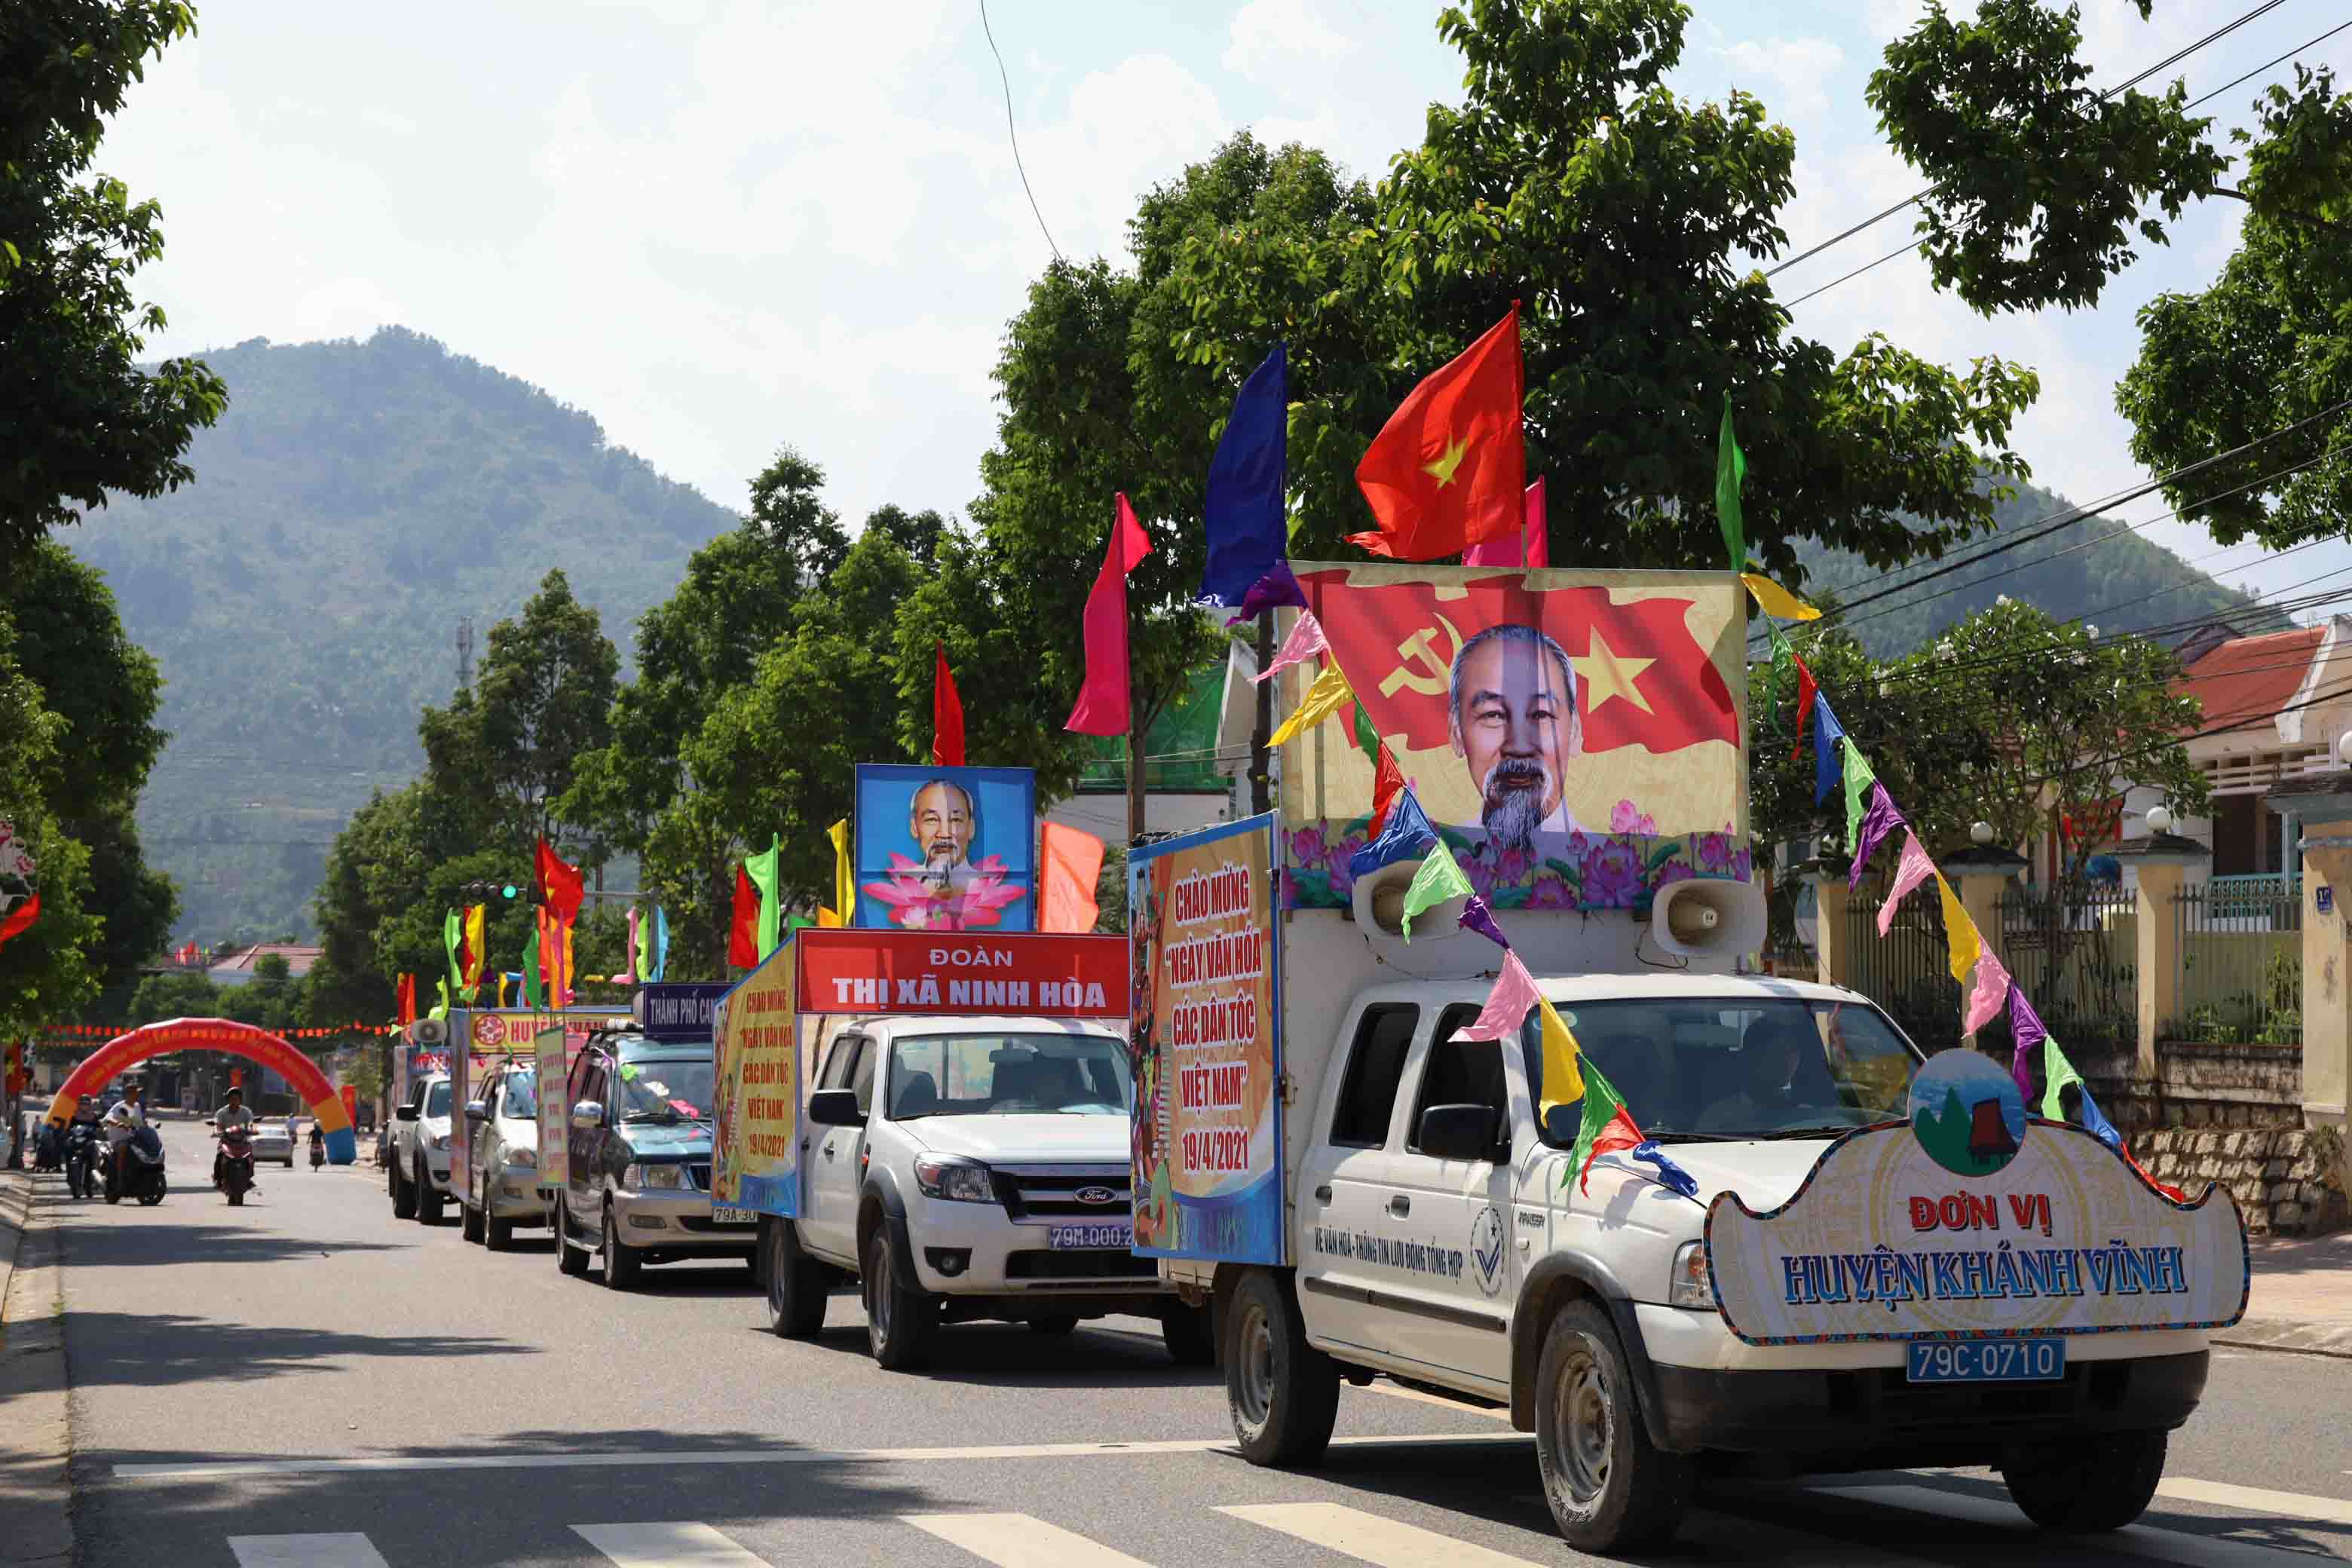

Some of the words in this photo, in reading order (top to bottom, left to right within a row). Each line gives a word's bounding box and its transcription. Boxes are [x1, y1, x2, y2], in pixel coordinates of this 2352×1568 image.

[1174, 872, 1208, 922] CHÀO
[1211, 864, 1250, 915] MỪNG
[929, 945, 1013, 967] ĐOÀN
[1206, 934, 1232, 979] VĂN
[1234, 924, 1262, 975] HÓA
[650, 988, 678, 1025] THÀNH
[680, 988, 698, 1025] PHỐ
[832, 977, 889, 1010] THỊ
[897, 973, 942, 1006] XÃ
[949, 979, 1030, 1007] NINH
[1039, 975, 1107, 1008] HÒA
[1173, 1000, 1198, 1046] CÁC
[1201, 998, 1227, 1043] DÂN
[1229, 992, 1254, 1048] TỘC
[743, 1057, 760, 1085] CÁC
[1181, 1061, 1210, 1116] VIỆT
[748, 1133, 785, 1159] 19/4/2021
[1182, 1131, 1249, 1171] 19/4/2021
[1084, 1190, 1107, 1200] Ford
[1909, 1190, 2000, 1232] ĐƠN
[2008, 1193, 2053, 1237] VỊ
[1315, 1227, 1323, 1253] XE
[1324, 1224, 1337, 1254] VĂN
[1355, 1230, 1377, 1263] THÔNG
[1377, 1238, 1389, 1265] TIN
[1390, 1238, 1404, 1269] LƯU
[1405, 1237, 1426, 1277] ĐỘNG
[1426, 1236, 1447, 1276] TỔNG
[1447, 1248, 1463, 1285] HỢP
[1780, 1242, 1930, 1312] HUYỆN
[1930, 1239, 2084, 1300] KHÁNH
[2081, 1238, 2189, 1295] VĨNH
